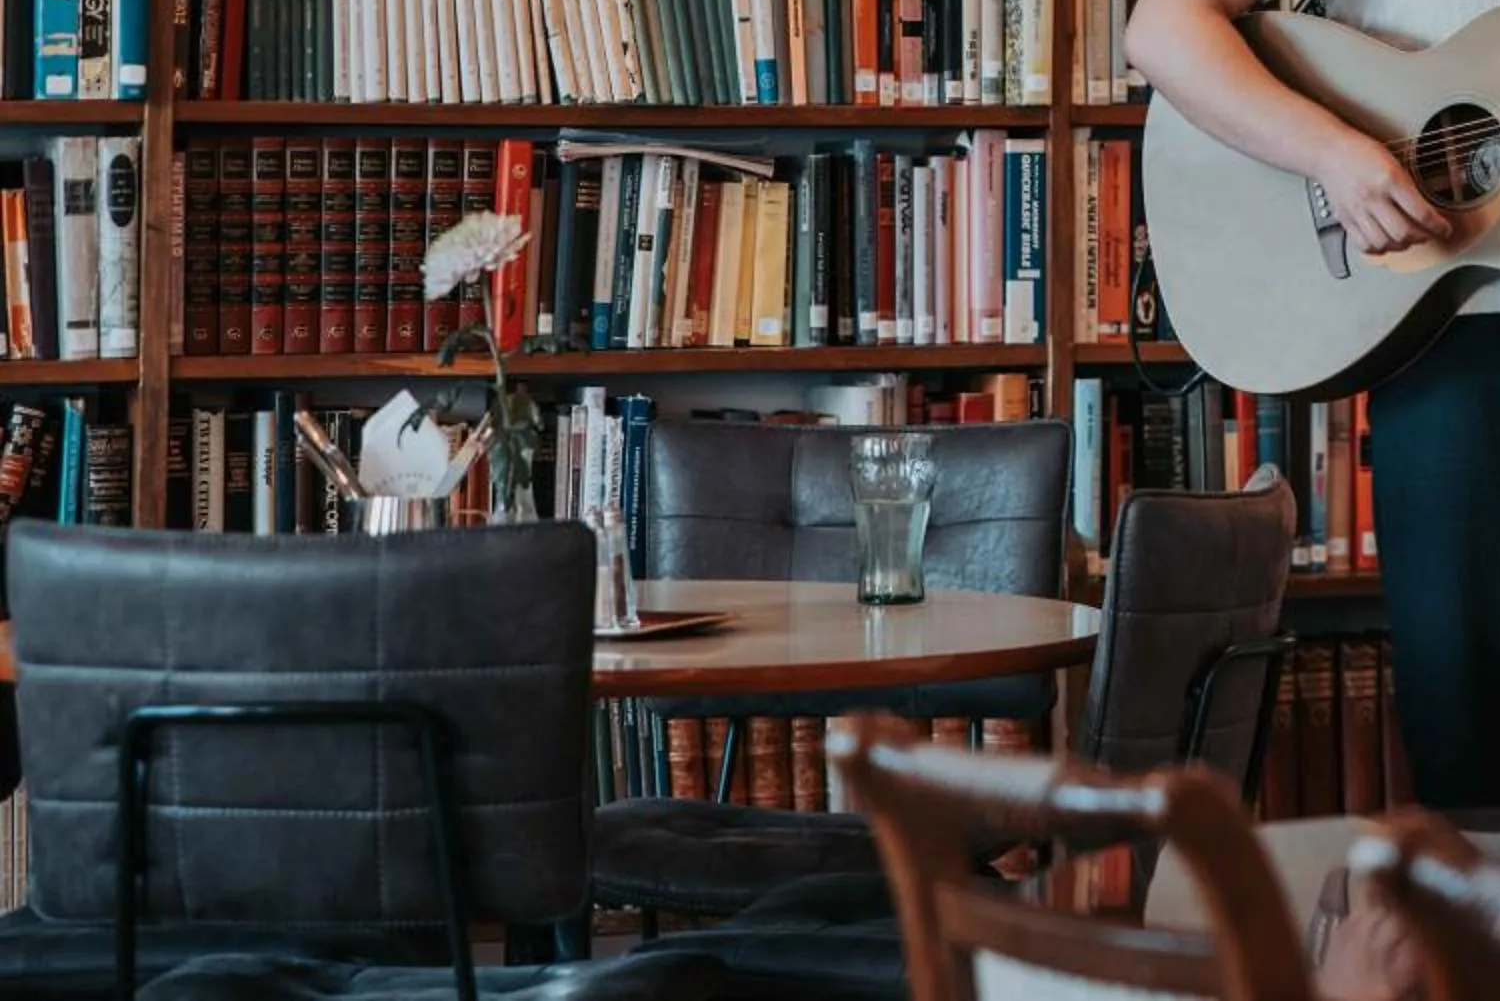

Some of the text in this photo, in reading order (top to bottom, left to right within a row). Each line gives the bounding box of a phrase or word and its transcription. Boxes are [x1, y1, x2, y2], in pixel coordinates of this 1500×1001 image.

[1021, 154, 1031, 267] QUICKBASIC BIBLE
[198, 418, 210, 529] TWELVE CITIES
